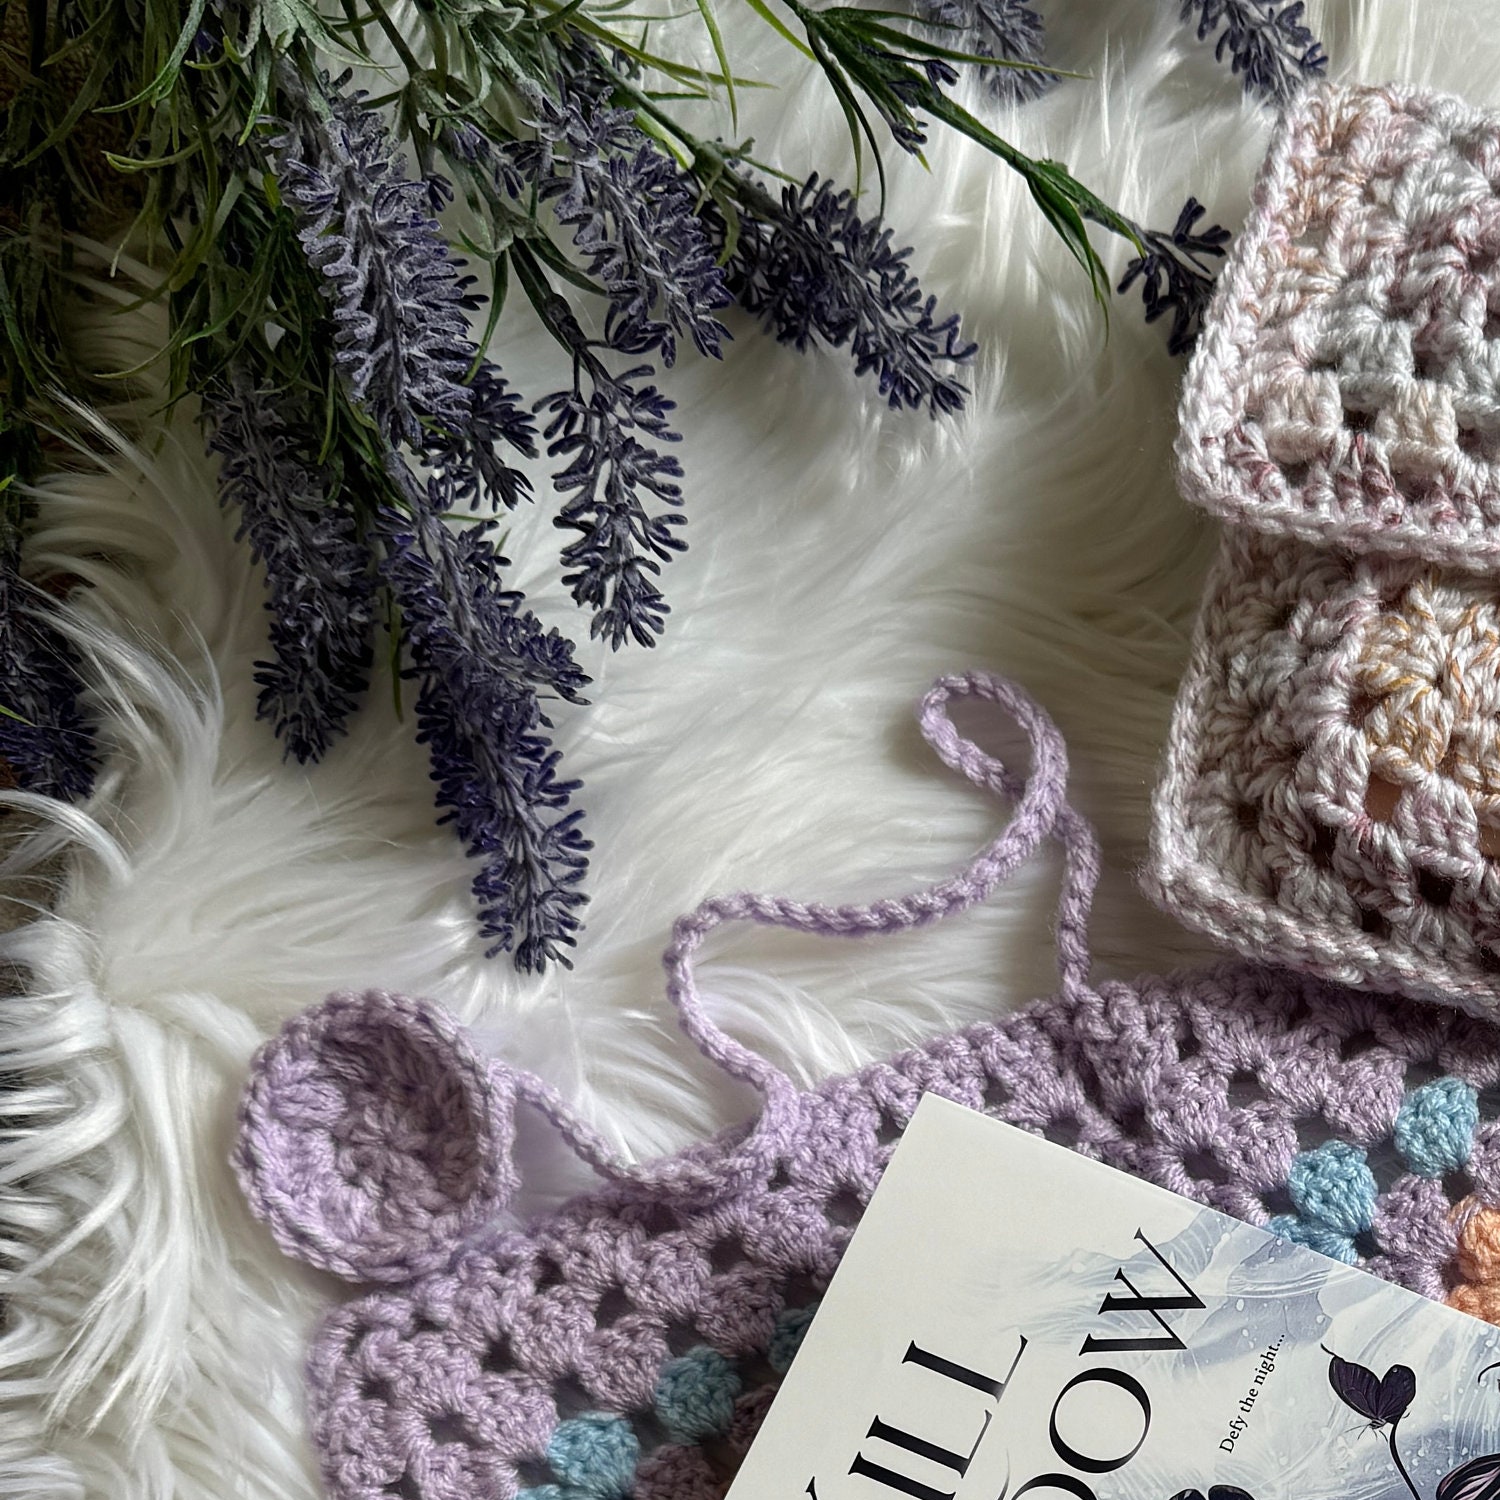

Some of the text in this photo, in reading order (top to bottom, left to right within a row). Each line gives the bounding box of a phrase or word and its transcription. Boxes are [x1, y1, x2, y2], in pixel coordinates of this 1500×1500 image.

[1219, 1334, 1285, 1454] Defy the night...
